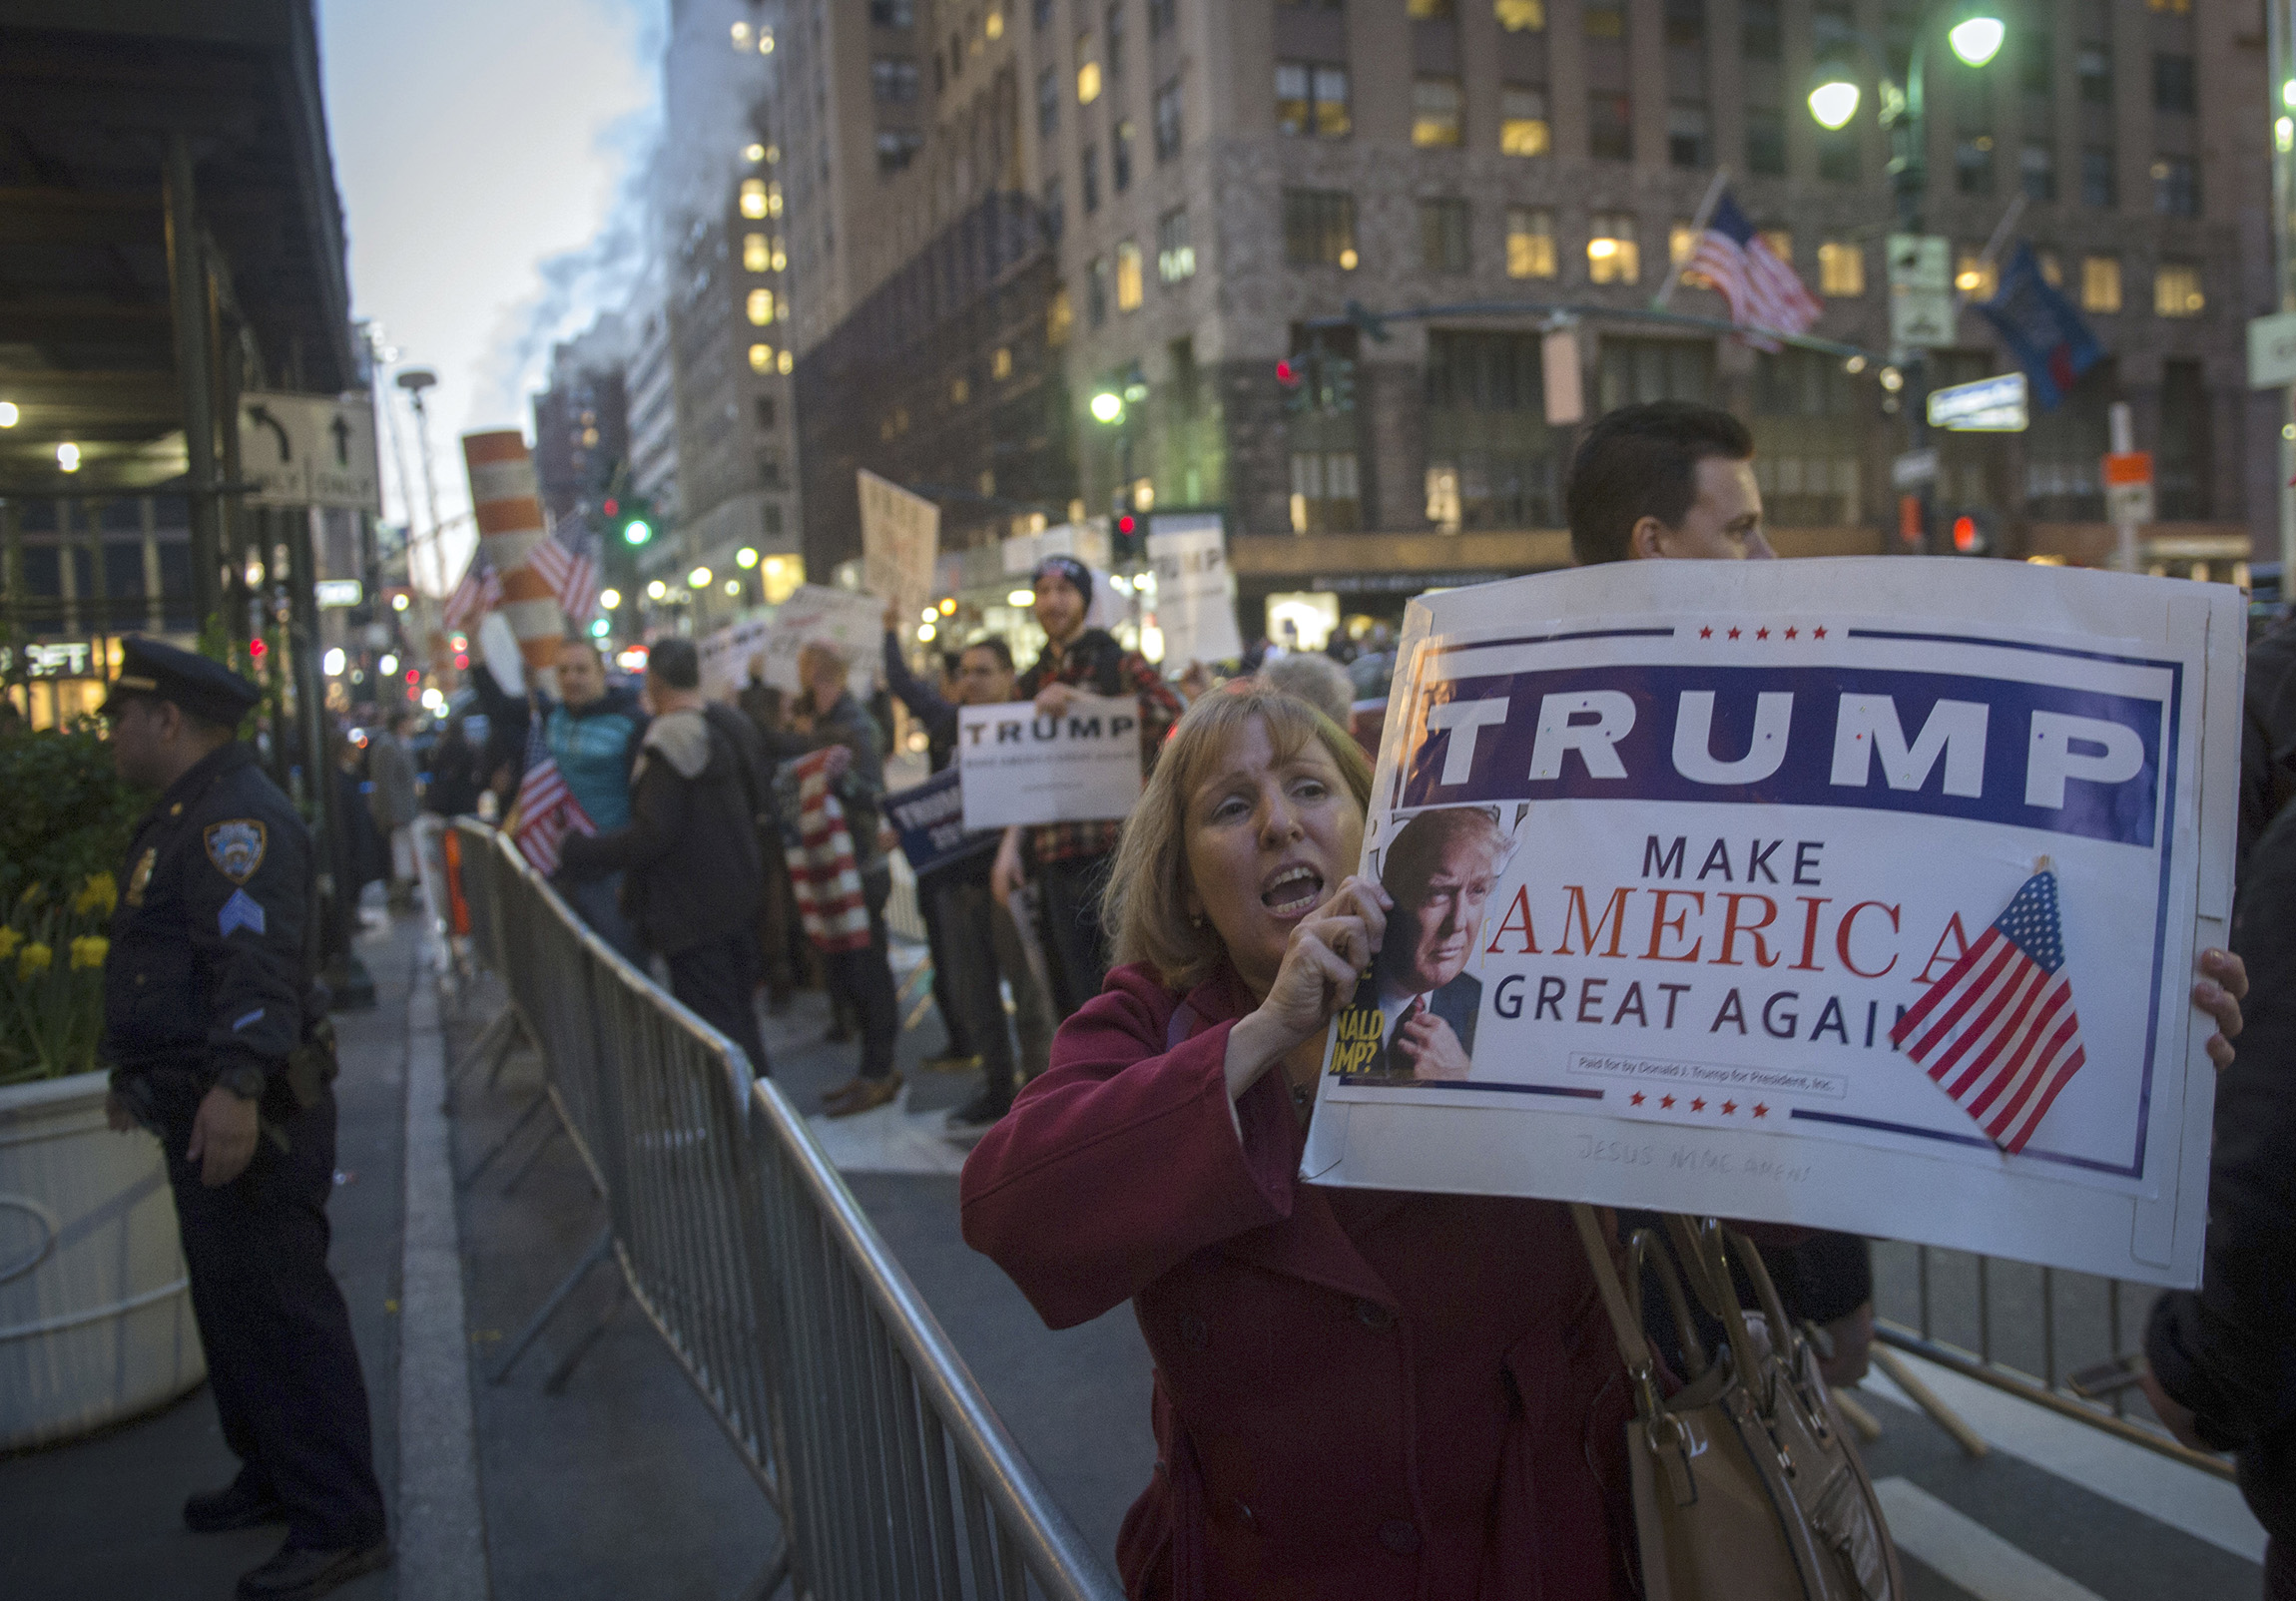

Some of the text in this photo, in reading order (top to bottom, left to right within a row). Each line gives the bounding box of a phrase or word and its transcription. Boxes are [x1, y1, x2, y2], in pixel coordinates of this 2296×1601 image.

[965, 715, 1135, 745] TRUMP
[1426, 690, 2145, 810] TRUMP
[1641, 834, 1825, 886] MAKE
[1485, 883, 1970, 987] AMERICA
[1493, 974, 1692, 1029] GREAT
[1578, 1057, 1603, 1070] Paid
[1604, 1058, 1620, 1071] for
[1621, 1060, 1637, 1075] by
[1637, 1061, 1680, 1077] Donald
[1691, 1065, 1730, 1083] Trump
[1731, 1069, 1749, 1082] for
[1575, 1134, 1653, 1166] JESUS
